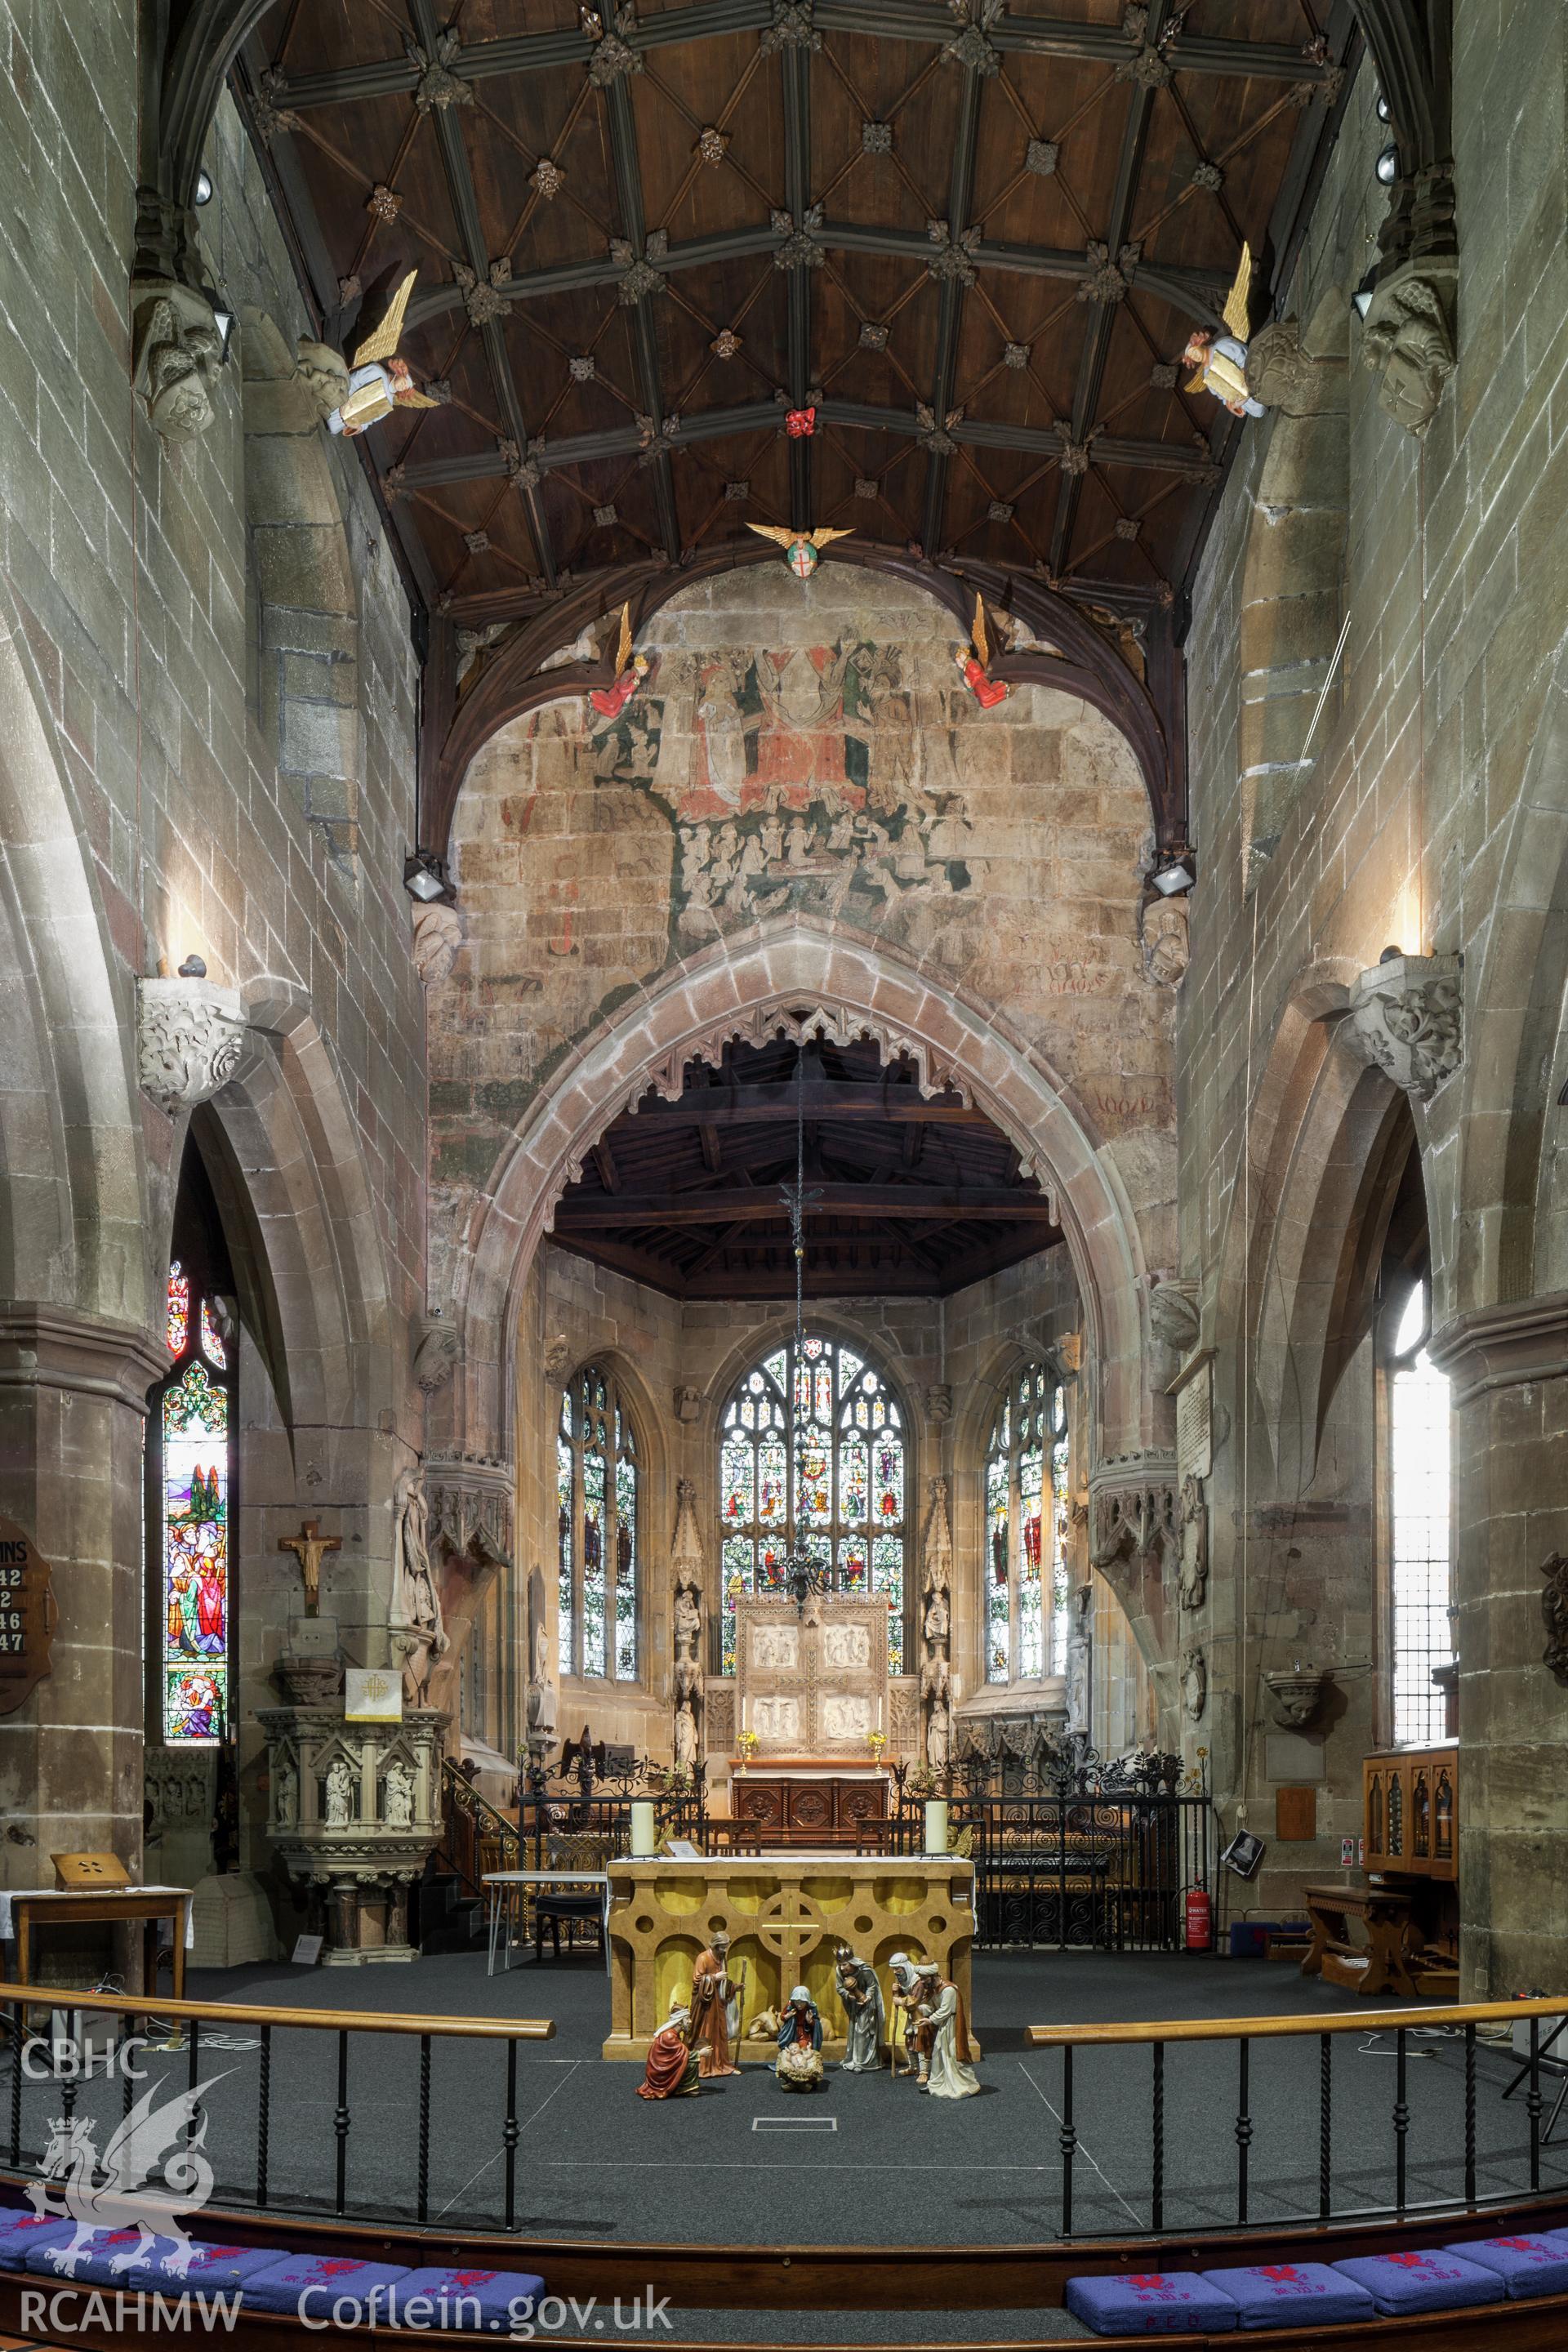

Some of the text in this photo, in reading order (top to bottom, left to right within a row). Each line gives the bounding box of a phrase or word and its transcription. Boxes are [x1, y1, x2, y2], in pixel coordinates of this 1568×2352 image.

[0, 1570, 20, 1586] 42
[0, 1591, 11, 1607] 2
[0, 1634, 22, 1650] 47
